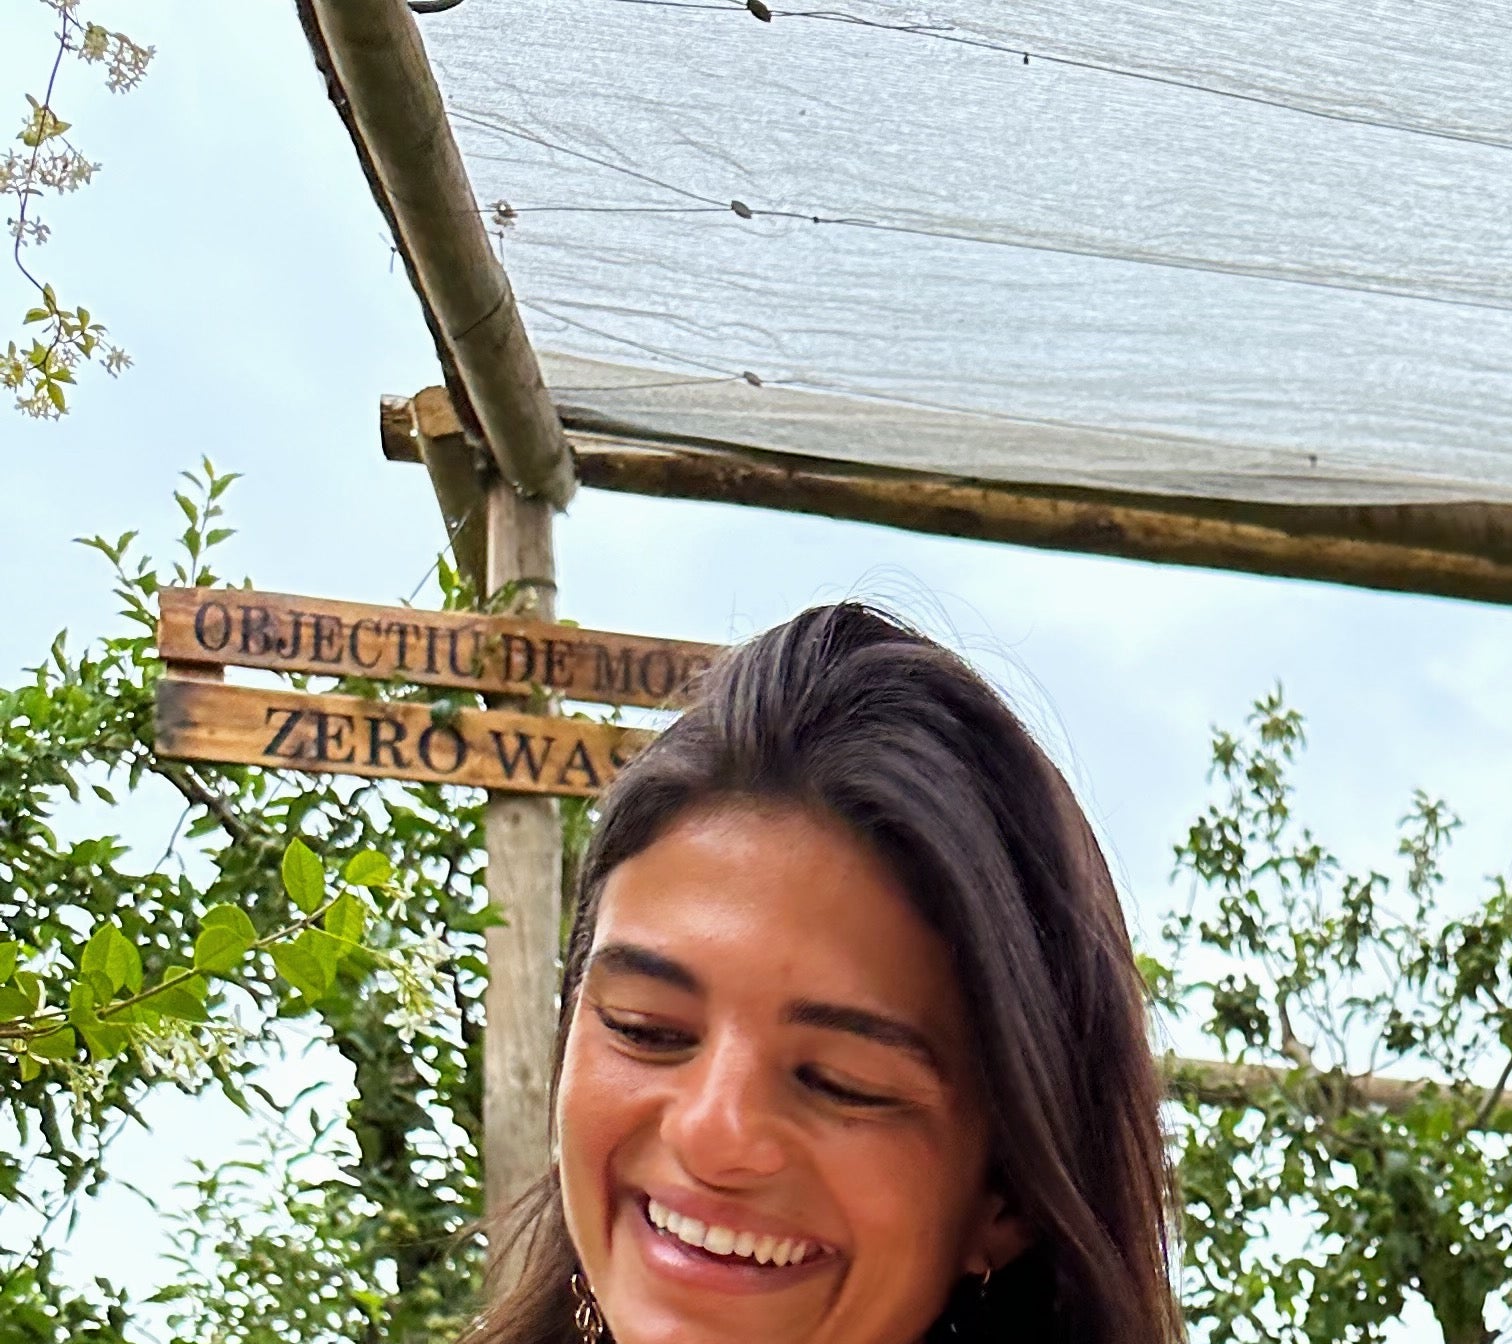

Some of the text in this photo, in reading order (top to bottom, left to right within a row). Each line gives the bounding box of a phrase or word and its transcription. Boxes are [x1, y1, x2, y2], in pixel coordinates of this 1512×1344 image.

[194, 601, 485, 678] OBJECTIU
[502, 634, 573, 687] DE
[263, 706, 467, 774] ZERO
